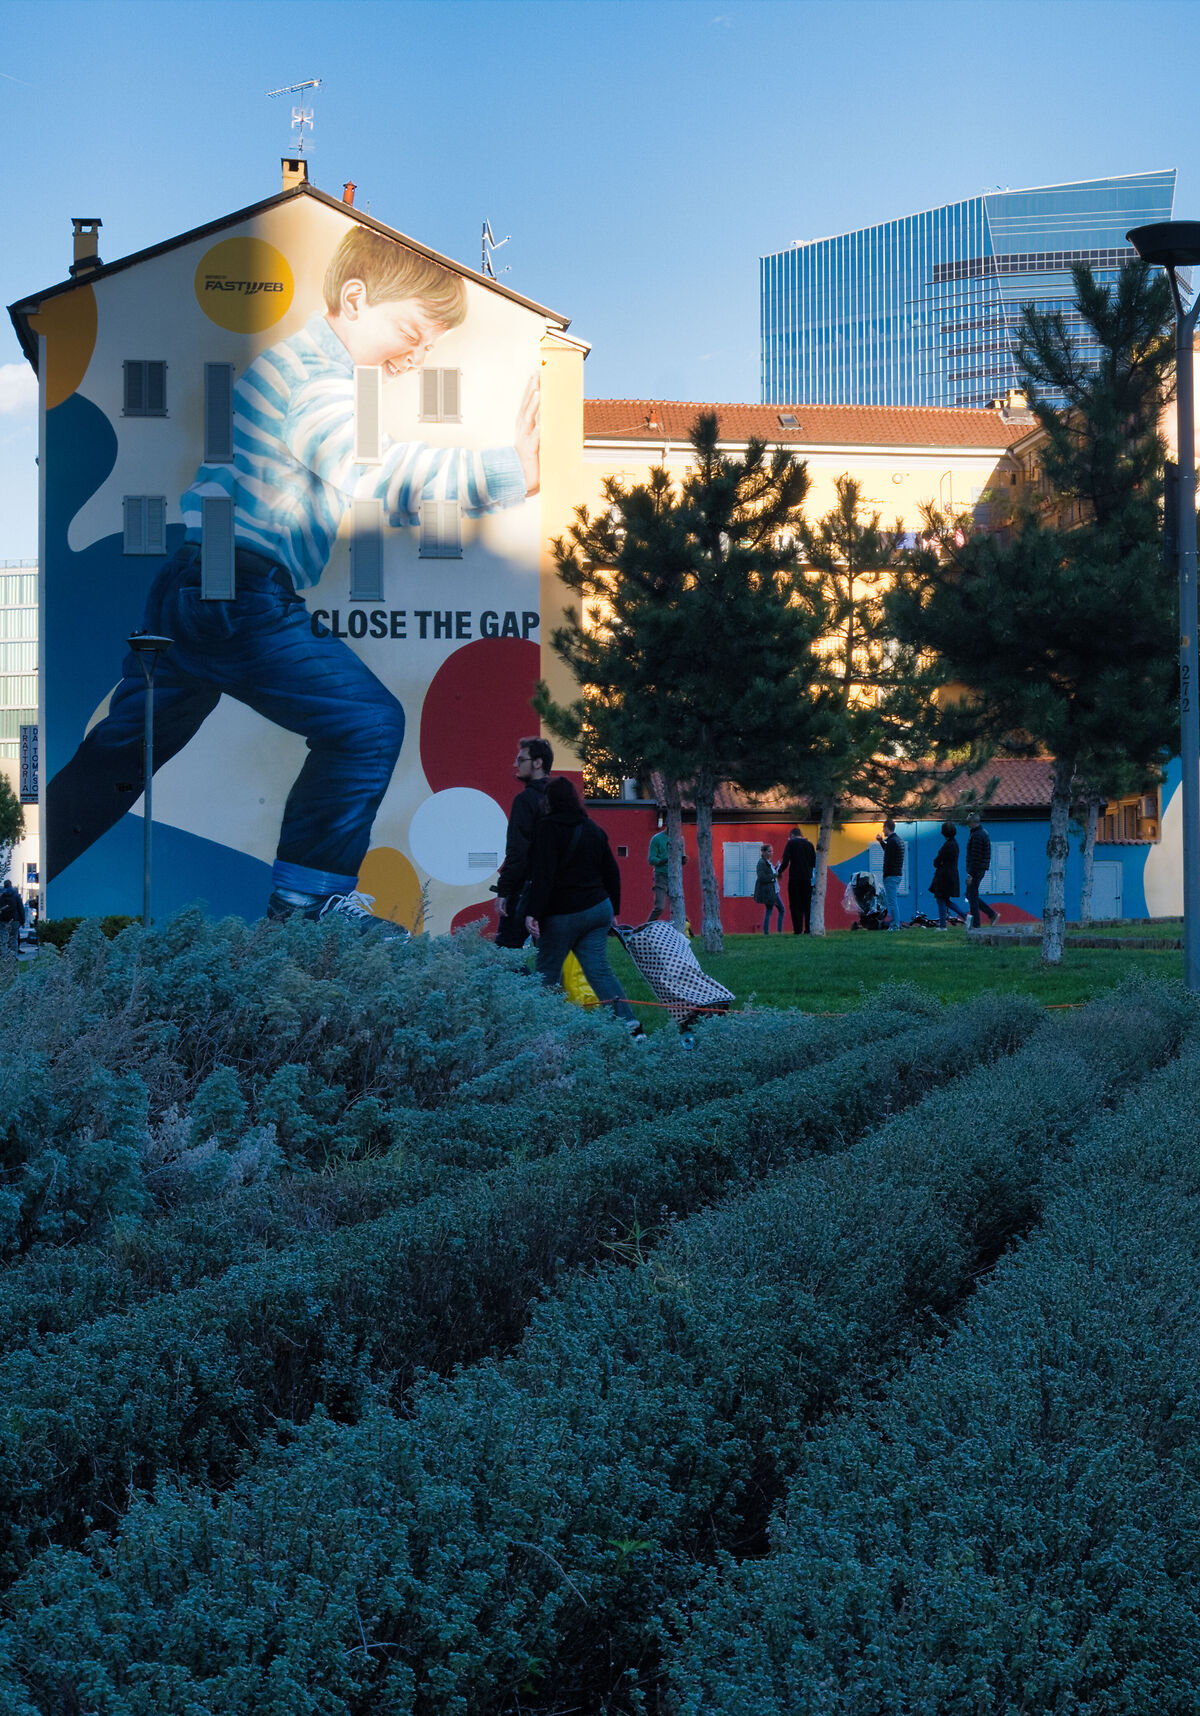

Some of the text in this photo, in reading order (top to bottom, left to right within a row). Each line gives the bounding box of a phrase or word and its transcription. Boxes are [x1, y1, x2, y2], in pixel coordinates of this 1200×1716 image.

[205, 281, 284, 295] FASTWEB
[310, 609, 540, 639] CLOSE THE GAP
[1182, 665, 1191, 713] 272
